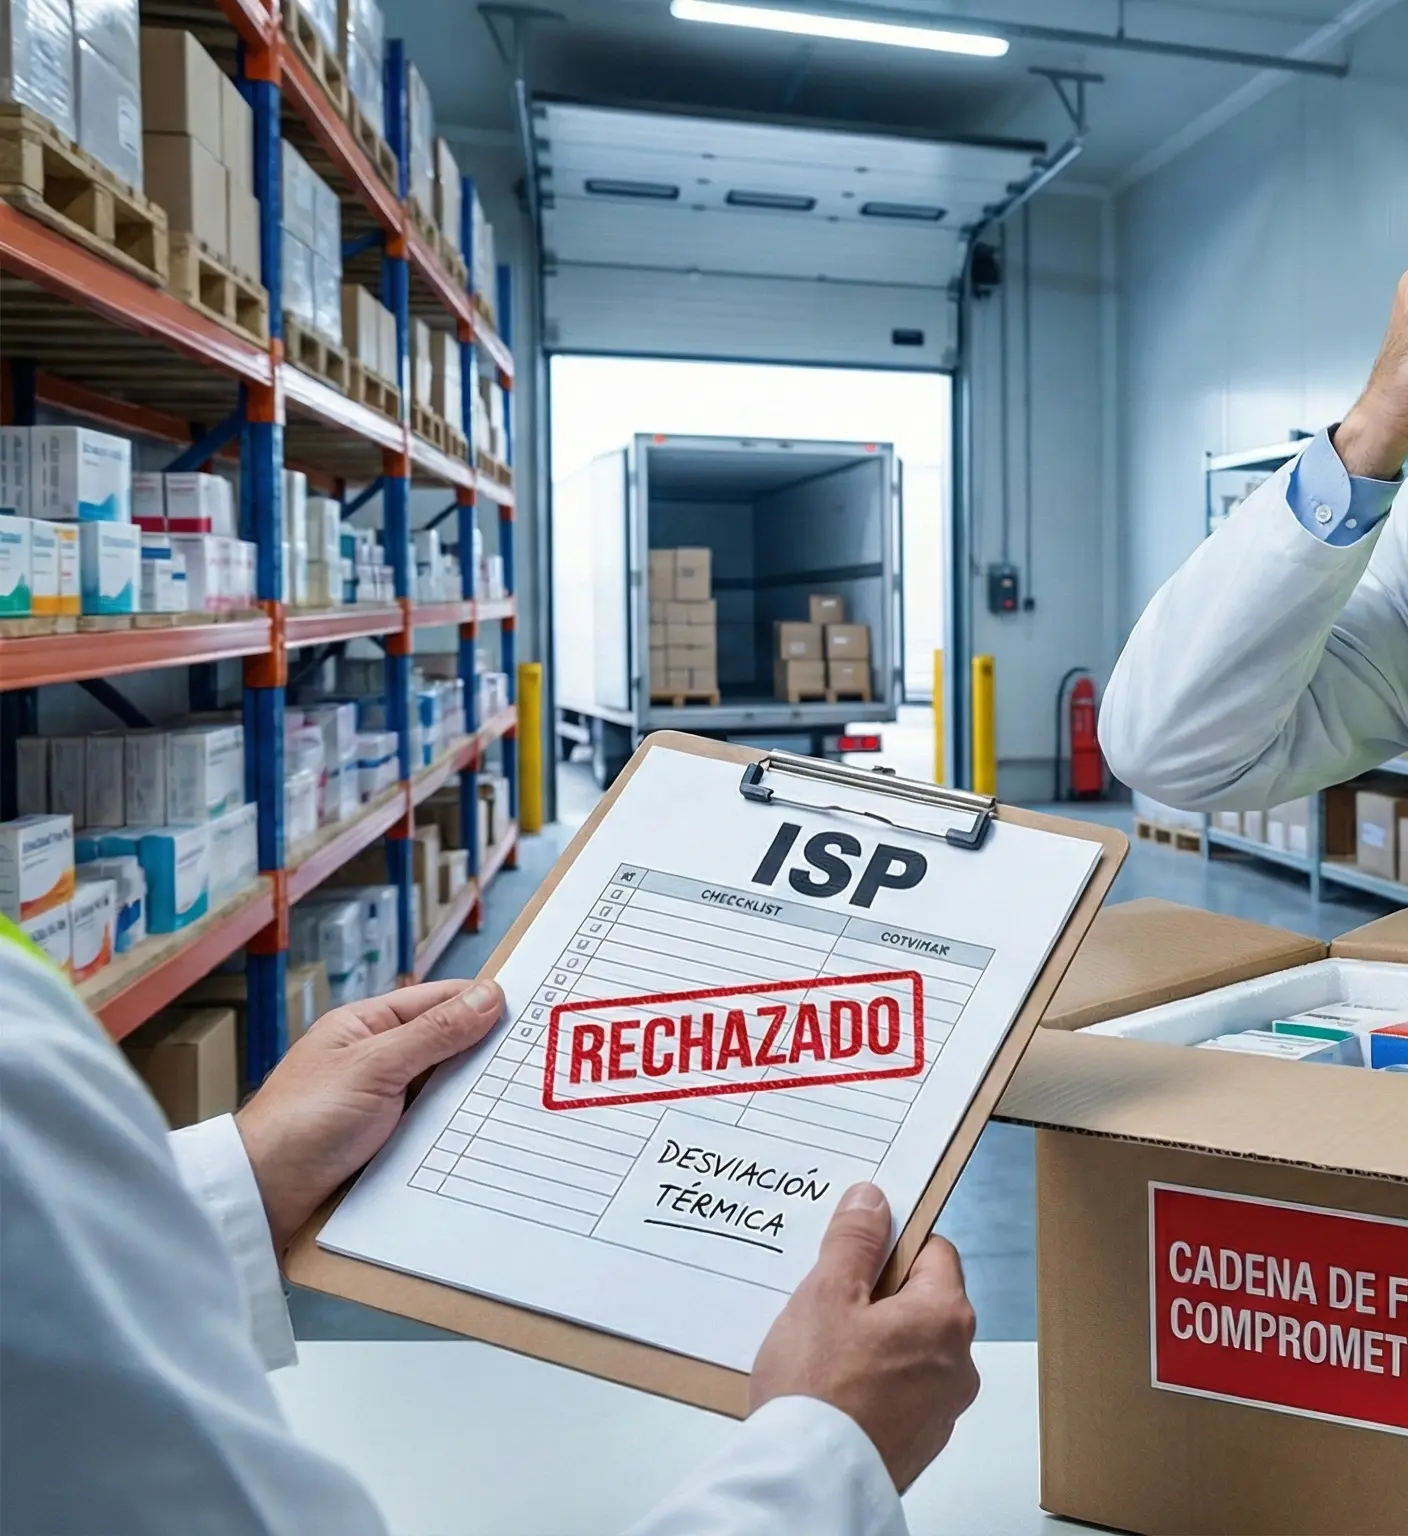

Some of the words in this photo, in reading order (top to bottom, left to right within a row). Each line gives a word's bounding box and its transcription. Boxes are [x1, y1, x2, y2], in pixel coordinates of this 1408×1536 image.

[751, 822, 928, 908] ISP
[569, 996, 902, 1086] RECHAZADO
[657, 1139, 830, 1201] DESVIACIÓN
[656, 1181, 785, 1237] TÉRMICA
[1168, 1240, 1319, 1306] CADENA
[1329, 1266, 1377, 1316] DE
